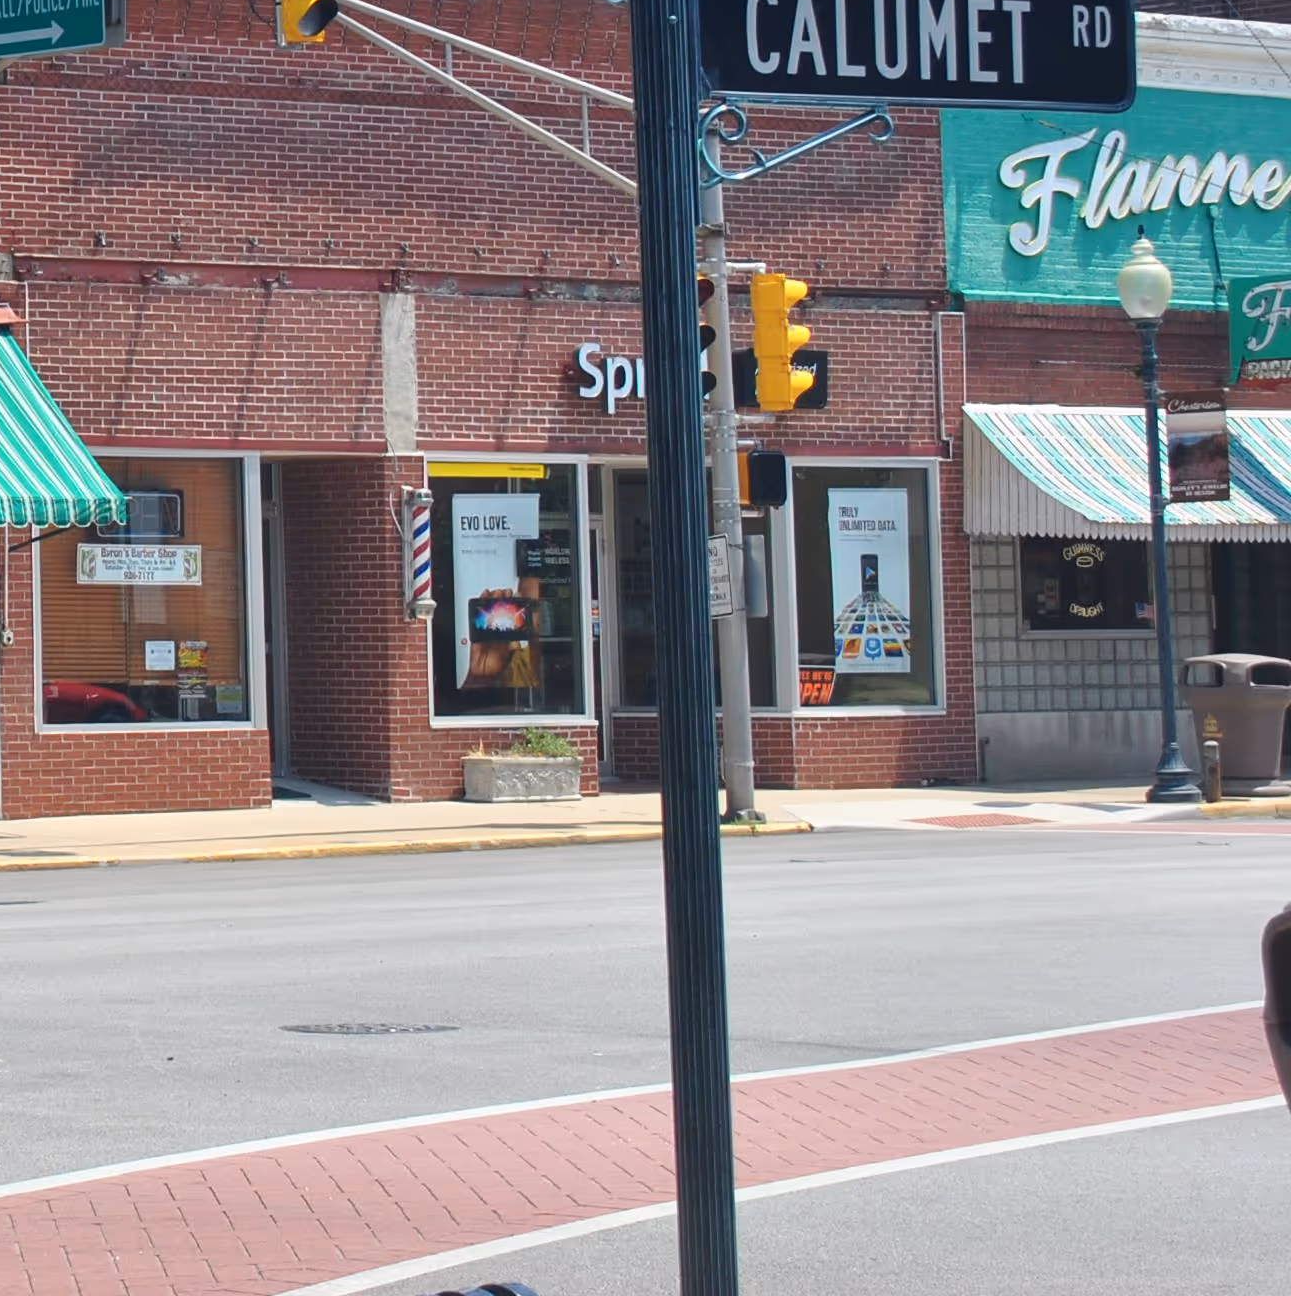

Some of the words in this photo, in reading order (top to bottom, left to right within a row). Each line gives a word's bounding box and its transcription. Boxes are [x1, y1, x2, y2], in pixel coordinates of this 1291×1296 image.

[1072, 3, 1113, 51] RD
[998, 126, 1291, 257] Flanne
[460, 516, 481, 531] EVO
[483, 515, 511, 531] LOVE.
[799, 683, 831, 705] PEN
